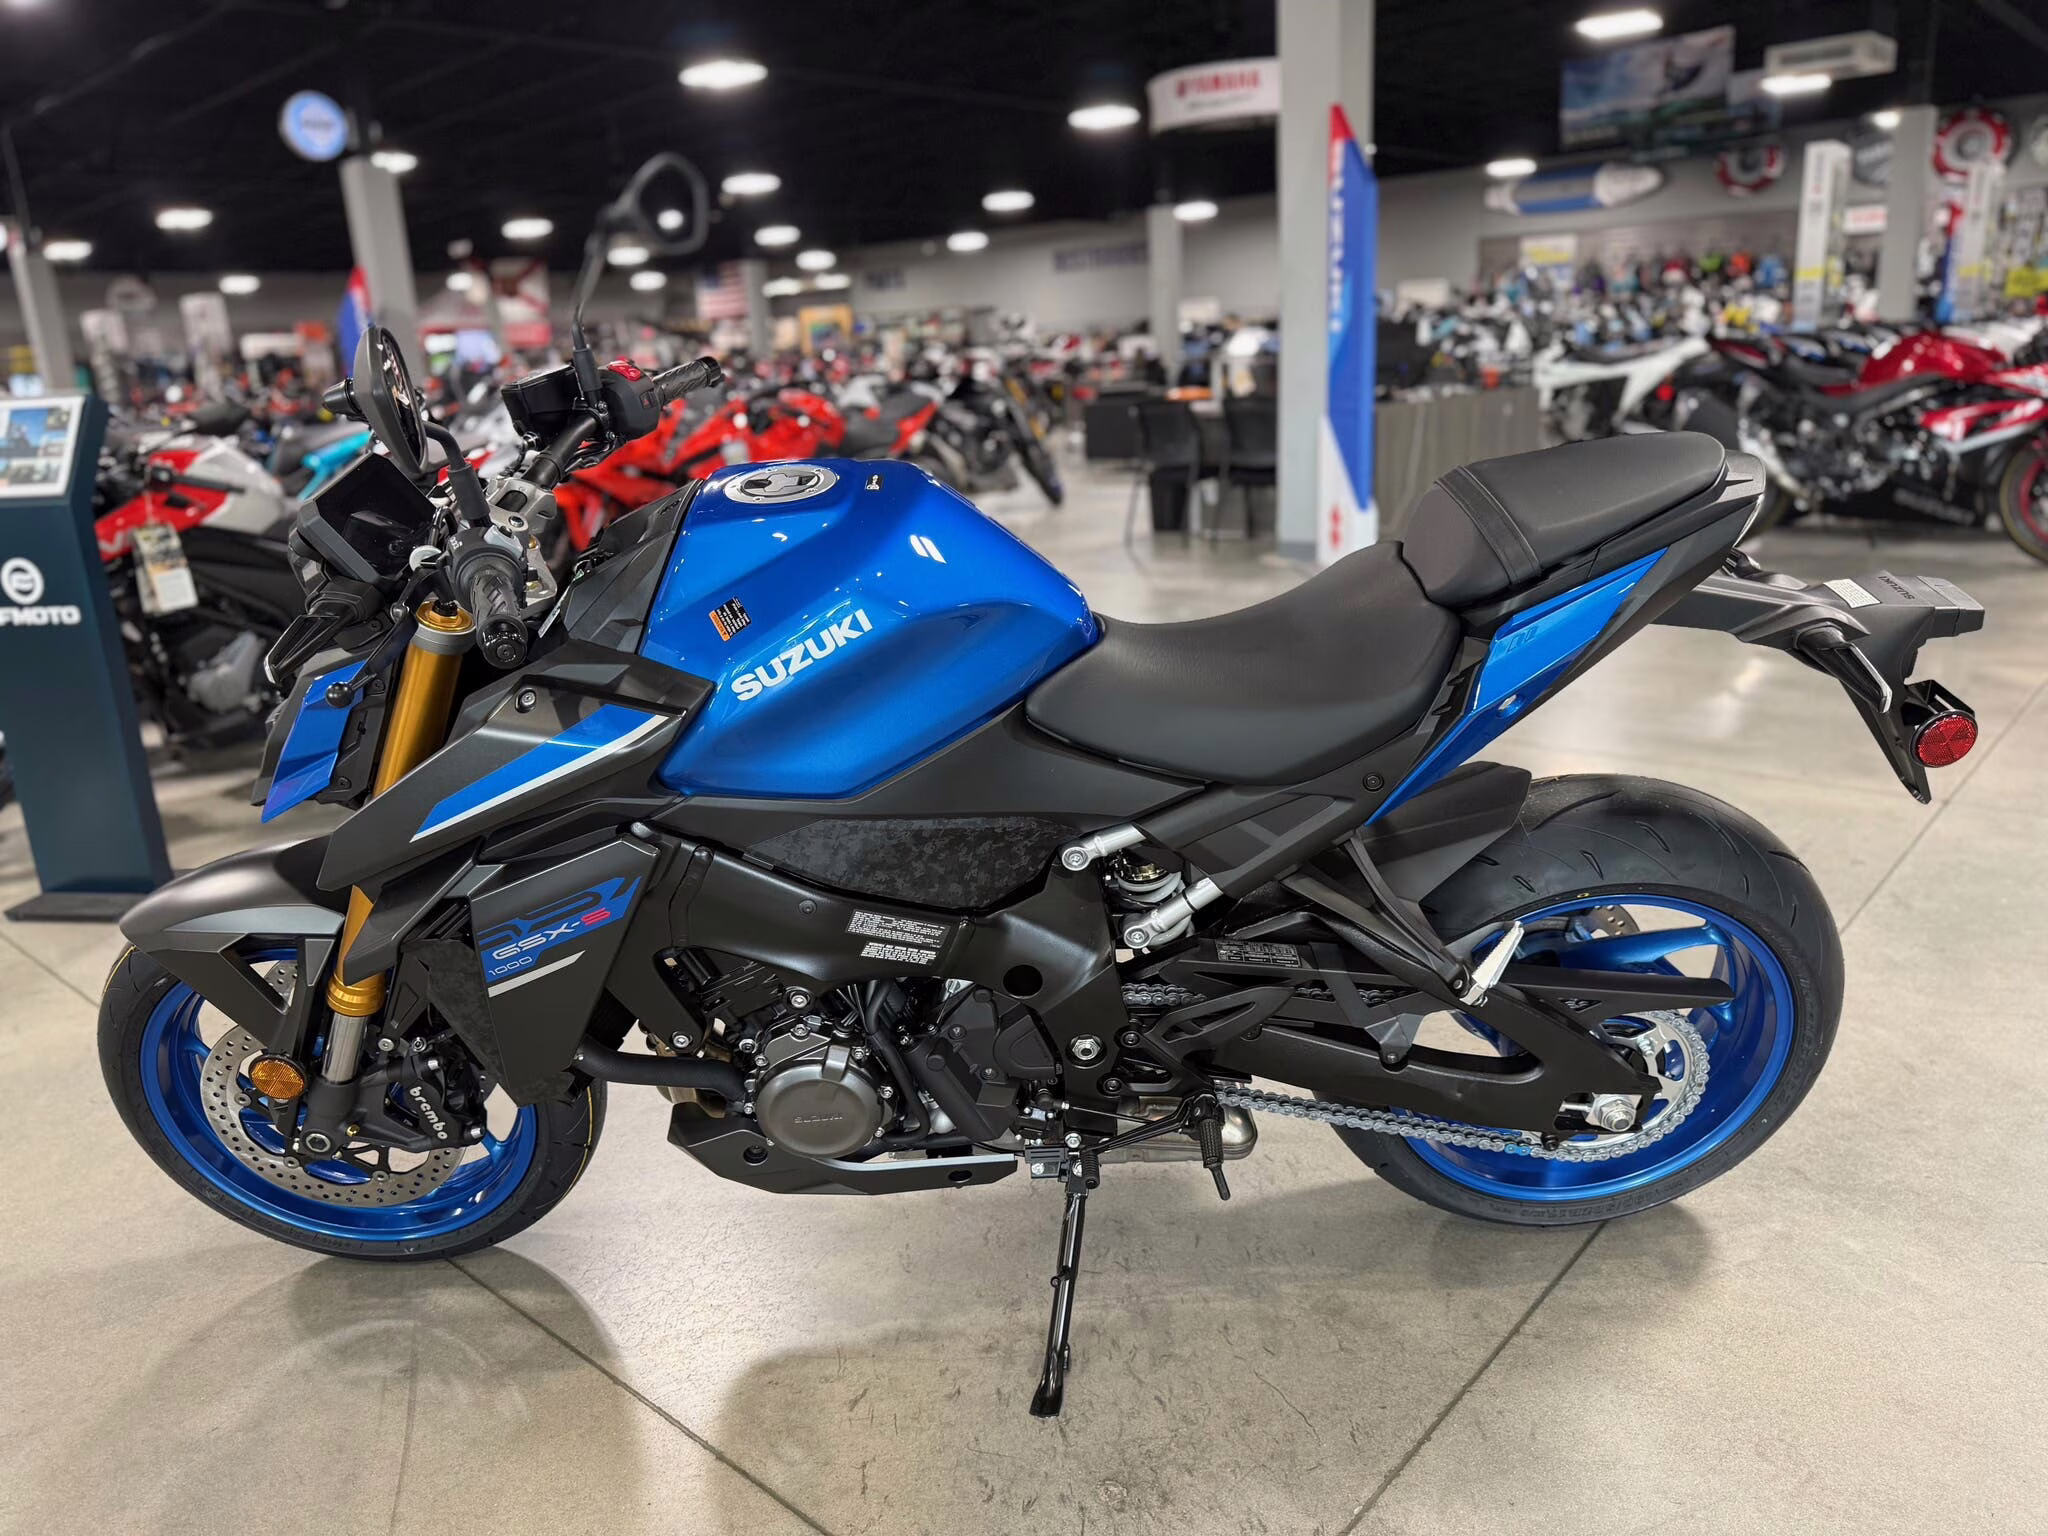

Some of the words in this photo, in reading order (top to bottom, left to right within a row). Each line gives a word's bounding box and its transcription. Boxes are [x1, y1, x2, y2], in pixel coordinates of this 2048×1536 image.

[1877, 575, 1916, 600] SUZUKI
[731, 608, 873, 701] SUZUKI
[492, 908, 611, 960] GSX-S
[488, 956, 533, 976] 1000
[410, 1086, 448, 1140] brembo
